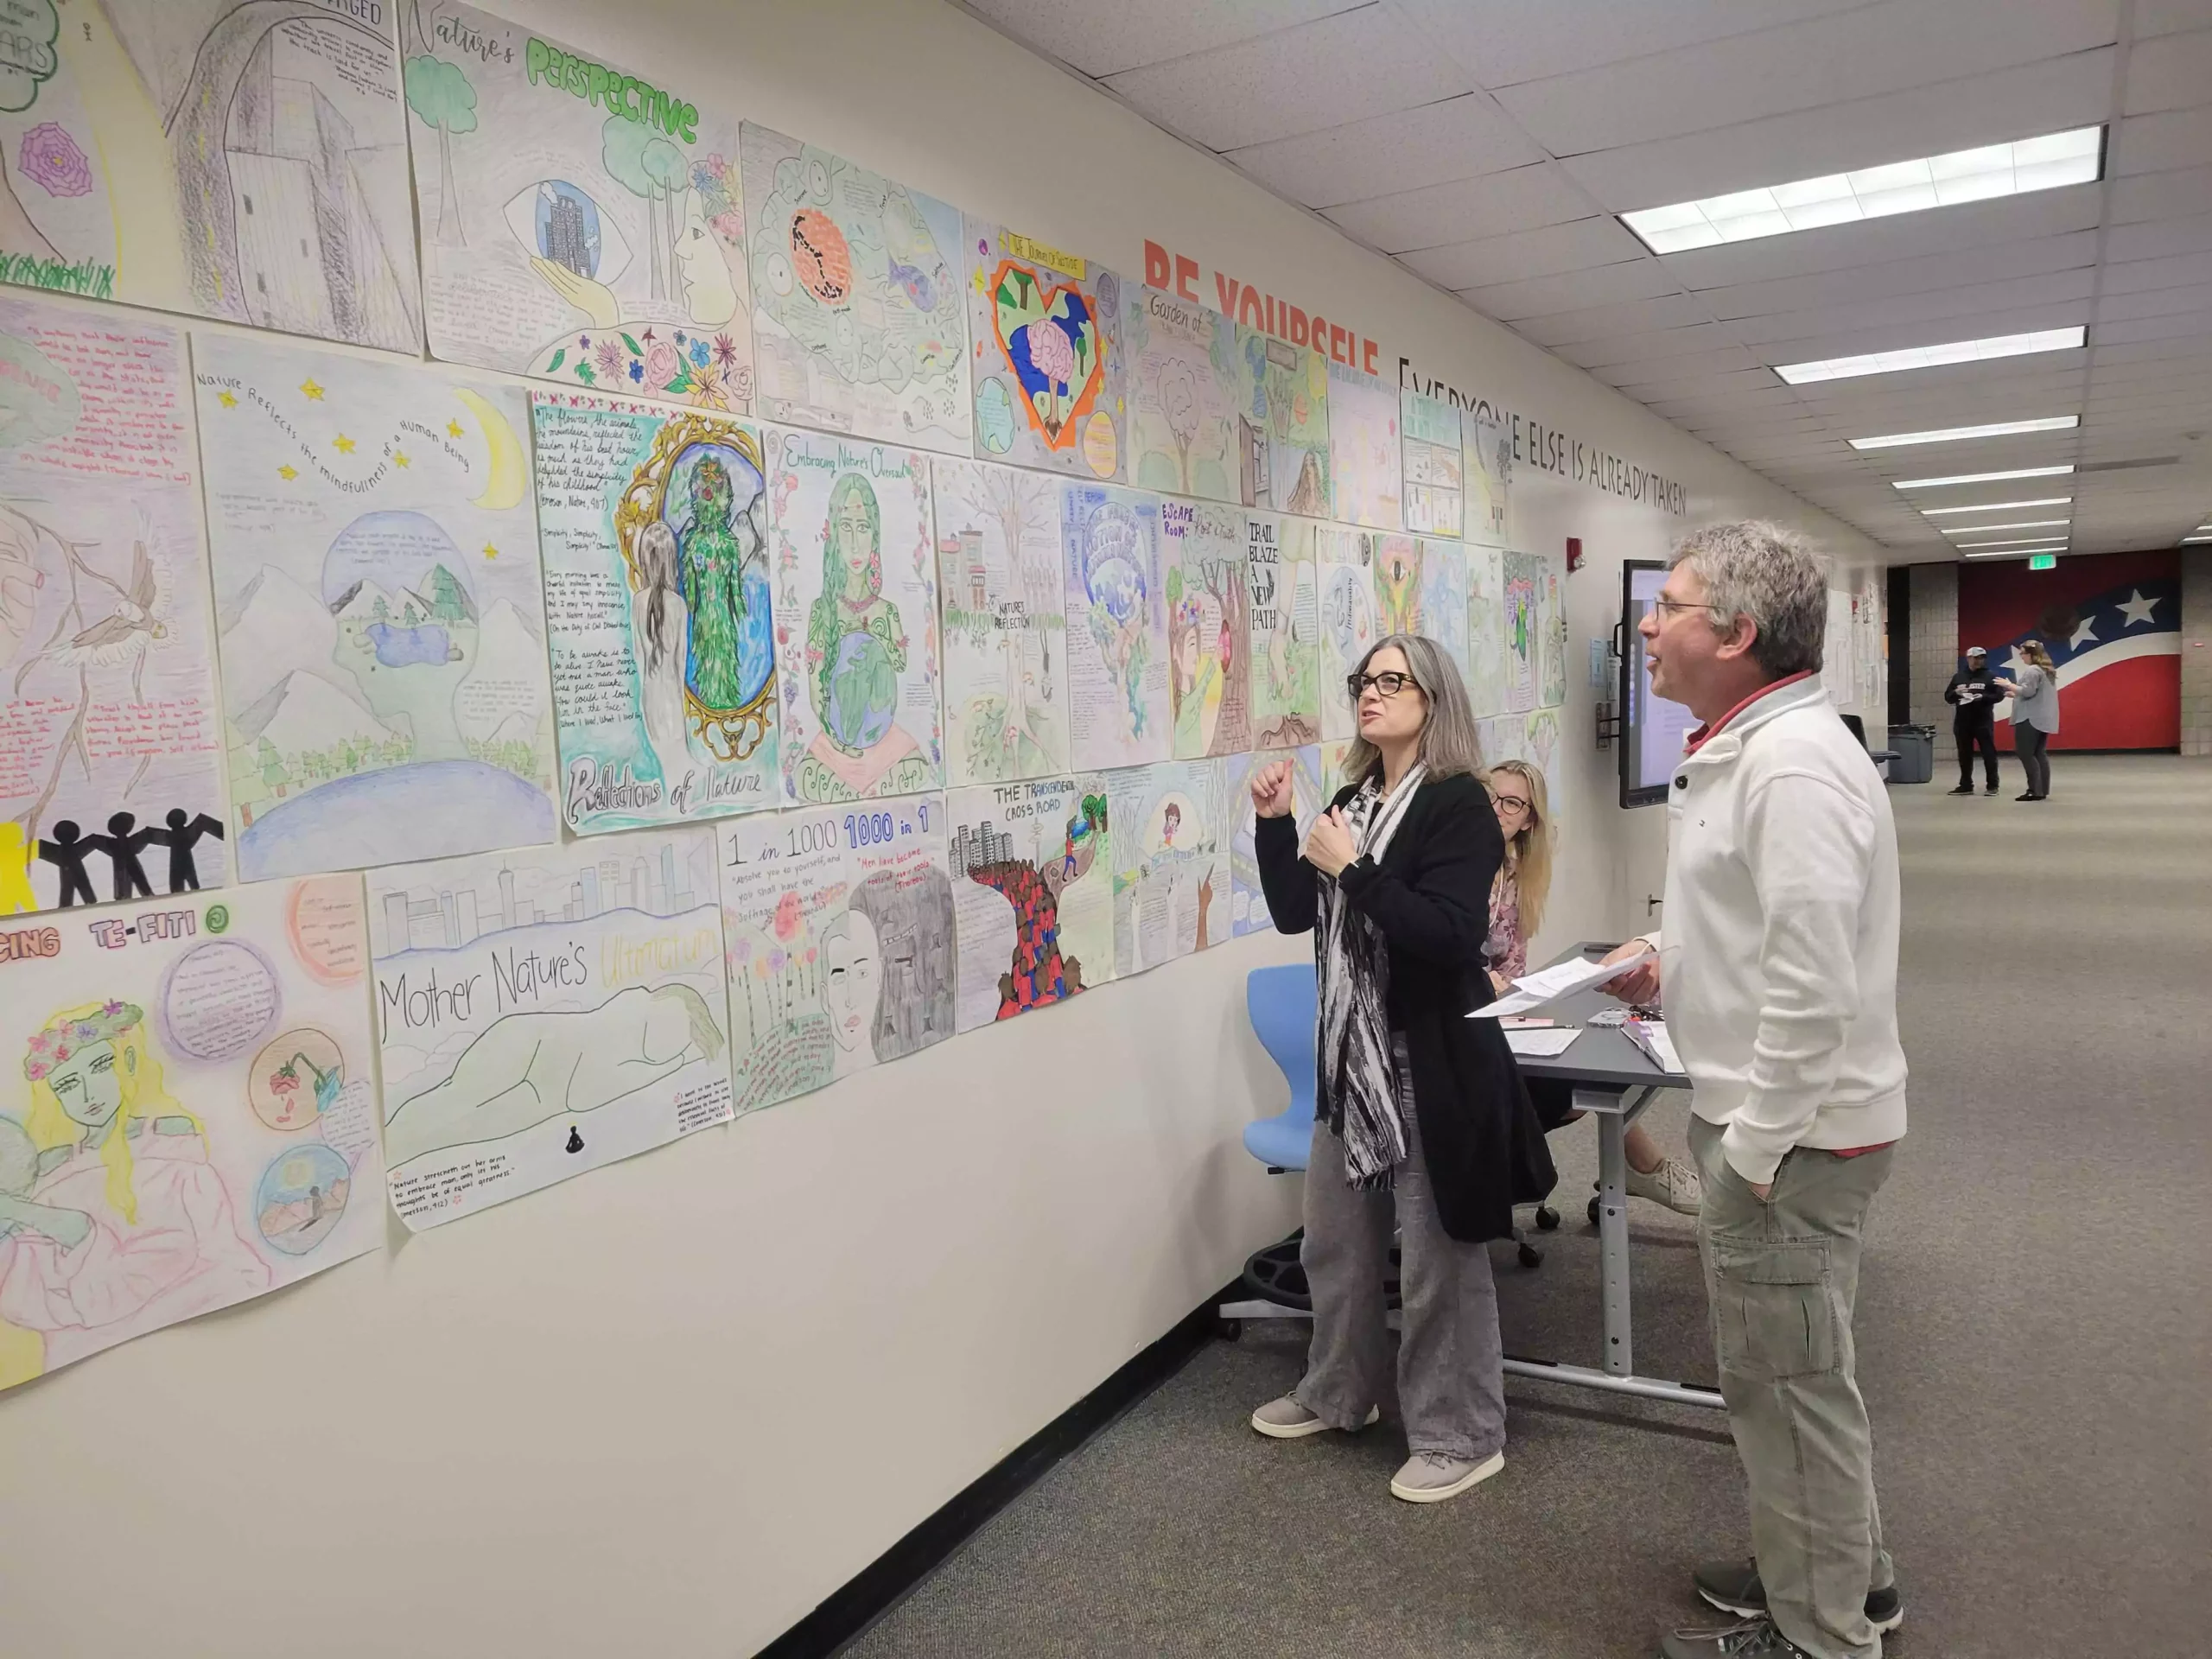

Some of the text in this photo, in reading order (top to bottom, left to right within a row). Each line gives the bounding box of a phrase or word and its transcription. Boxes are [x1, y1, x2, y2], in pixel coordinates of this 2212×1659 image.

[1150, 295, 1188, 328] Garden
[1192, 312, 1203, 333] of
[196, 373, 242, 390] Nature
[248, 387, 296, 439] Reflects
[301, 442, 317, 465] the
[383, 442, 391, 456] of
[394, 434, 401, 442] a
[784, 433, 836, 479] Embracing
[838, 442, 868, 469] Nature's
[1529, 421, 1687, 518] ELSE IS ALREADY TAKEN
[1249, 522, 1274, 543] TRAIL
[1249, 545, 1279, 564] BLAZE
[1250, 564, 1258, 583] A
[1251, 582, 1274, 606] NEW
[1251, 608, 1276, 630] PATH
[566, 756, 762, 824] Reflections of Nature
[993, 785, 1020, 804] THE
[1036, 798, 1060, 814] ROAD
[727, 804, 929, 867] 1 in 1000 1000 in 1
[767, 868, 780, 881] you
[827, 854, 841, 863] and
[879, 855, 893, 867] have
[896, 848, 921, 864] become
[738, 877, 815, 905] you shall have the
[89, 910, 196, 949] TE-FITI
[380, 968, 481, 1045] Mother
[492, 941, 588, 1013] Nature's
[475, 1159, 486, 1167] her
[489, 1154, 505, 1164] arms
[407, 1184, 436, 1196] embrace
[460, 1172, 474, 1181] only
[454, 1181, 474, 1192] equal
